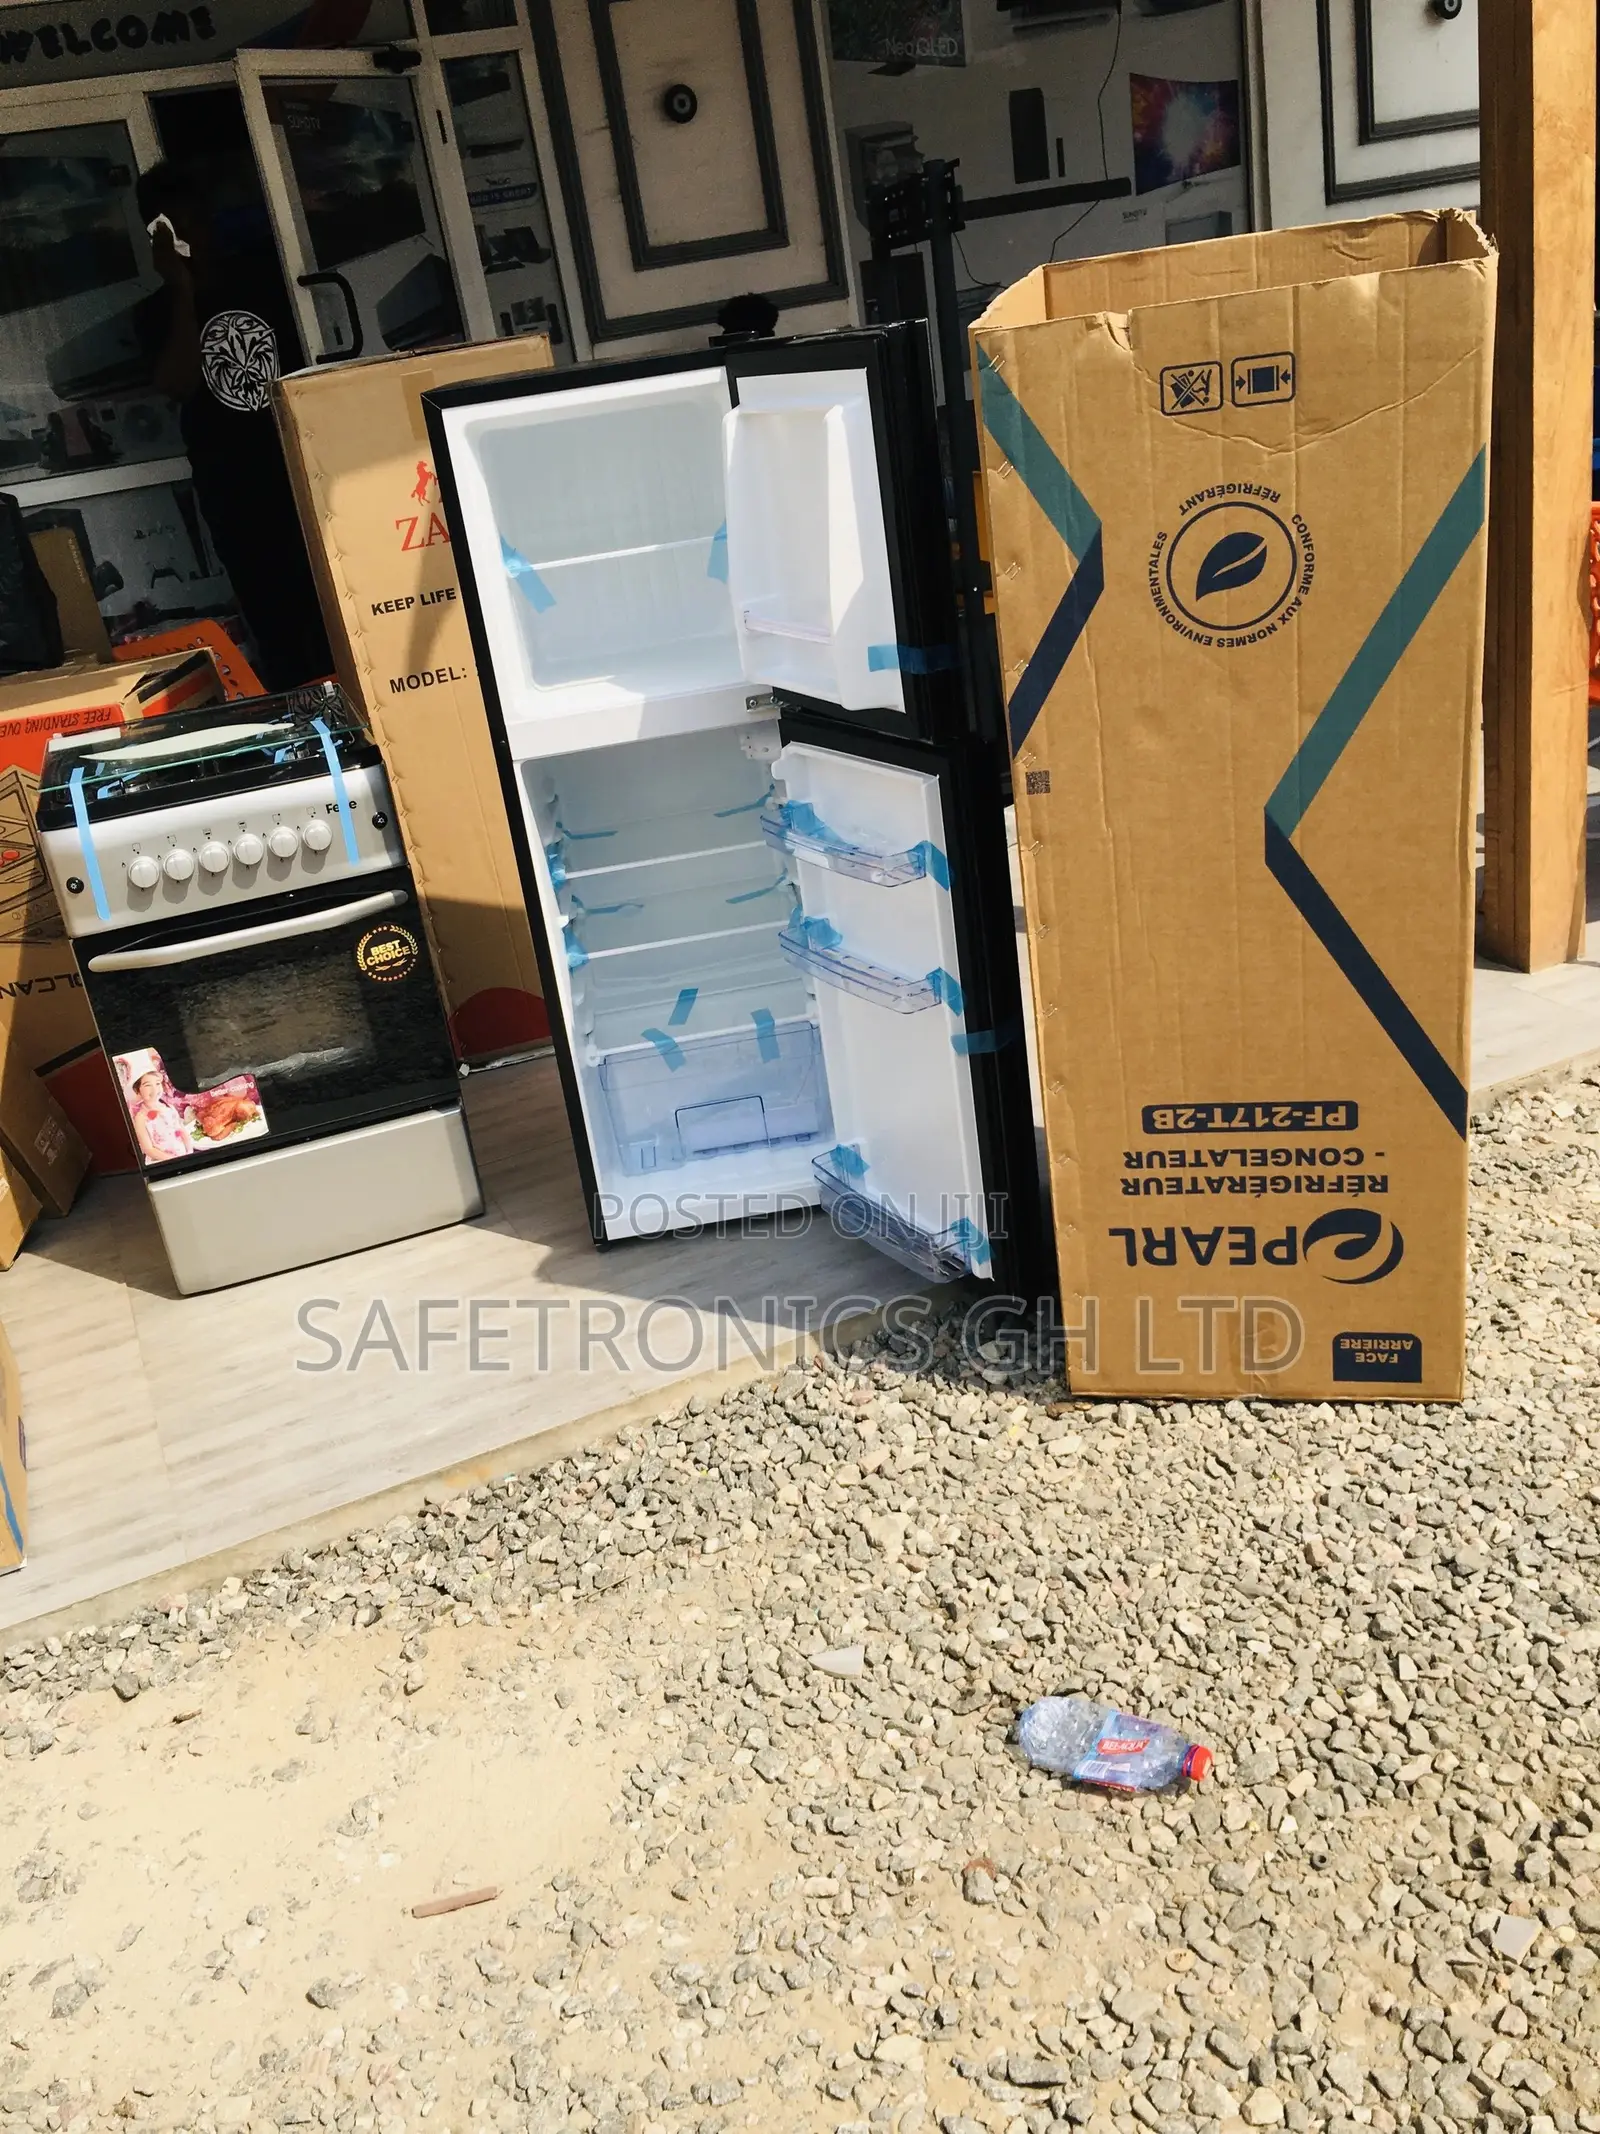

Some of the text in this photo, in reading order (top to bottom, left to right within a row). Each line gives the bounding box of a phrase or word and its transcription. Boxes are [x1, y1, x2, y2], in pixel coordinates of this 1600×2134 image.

[0, 6, 216, 64] WELCOME
[1177, 482, 1282, 517] RÉFRIGÉRANT
[1148, 513, 1316, 648] CONFORME AUX NORMES ENVIRONMENTALES
[371, 587, 457, 616] KEEP LIFE
[389, 667, 468, 694] MODEL:
[24, 712, 81, 735] STANDING
[83, 707, 112, 725] FREE
[325, 800, 357, 815] Fee
[366, 945, 411, 966] CHOICE
[370, 939, 400, 957] BEST
[1152, 1104, 1347, 1130] PF-217T-2B
[1123, 1147, 1364, 1169] CONGELATEUR
[1120, 1174, 1389, 1198] RÉFRIGÉRATEUR
[1108, 1225, 1298, 1267] PEARL
[1340, 1337, 1414, 1353] ARRIÈRE
[1355, 1352, 1399, 1364] FACE
